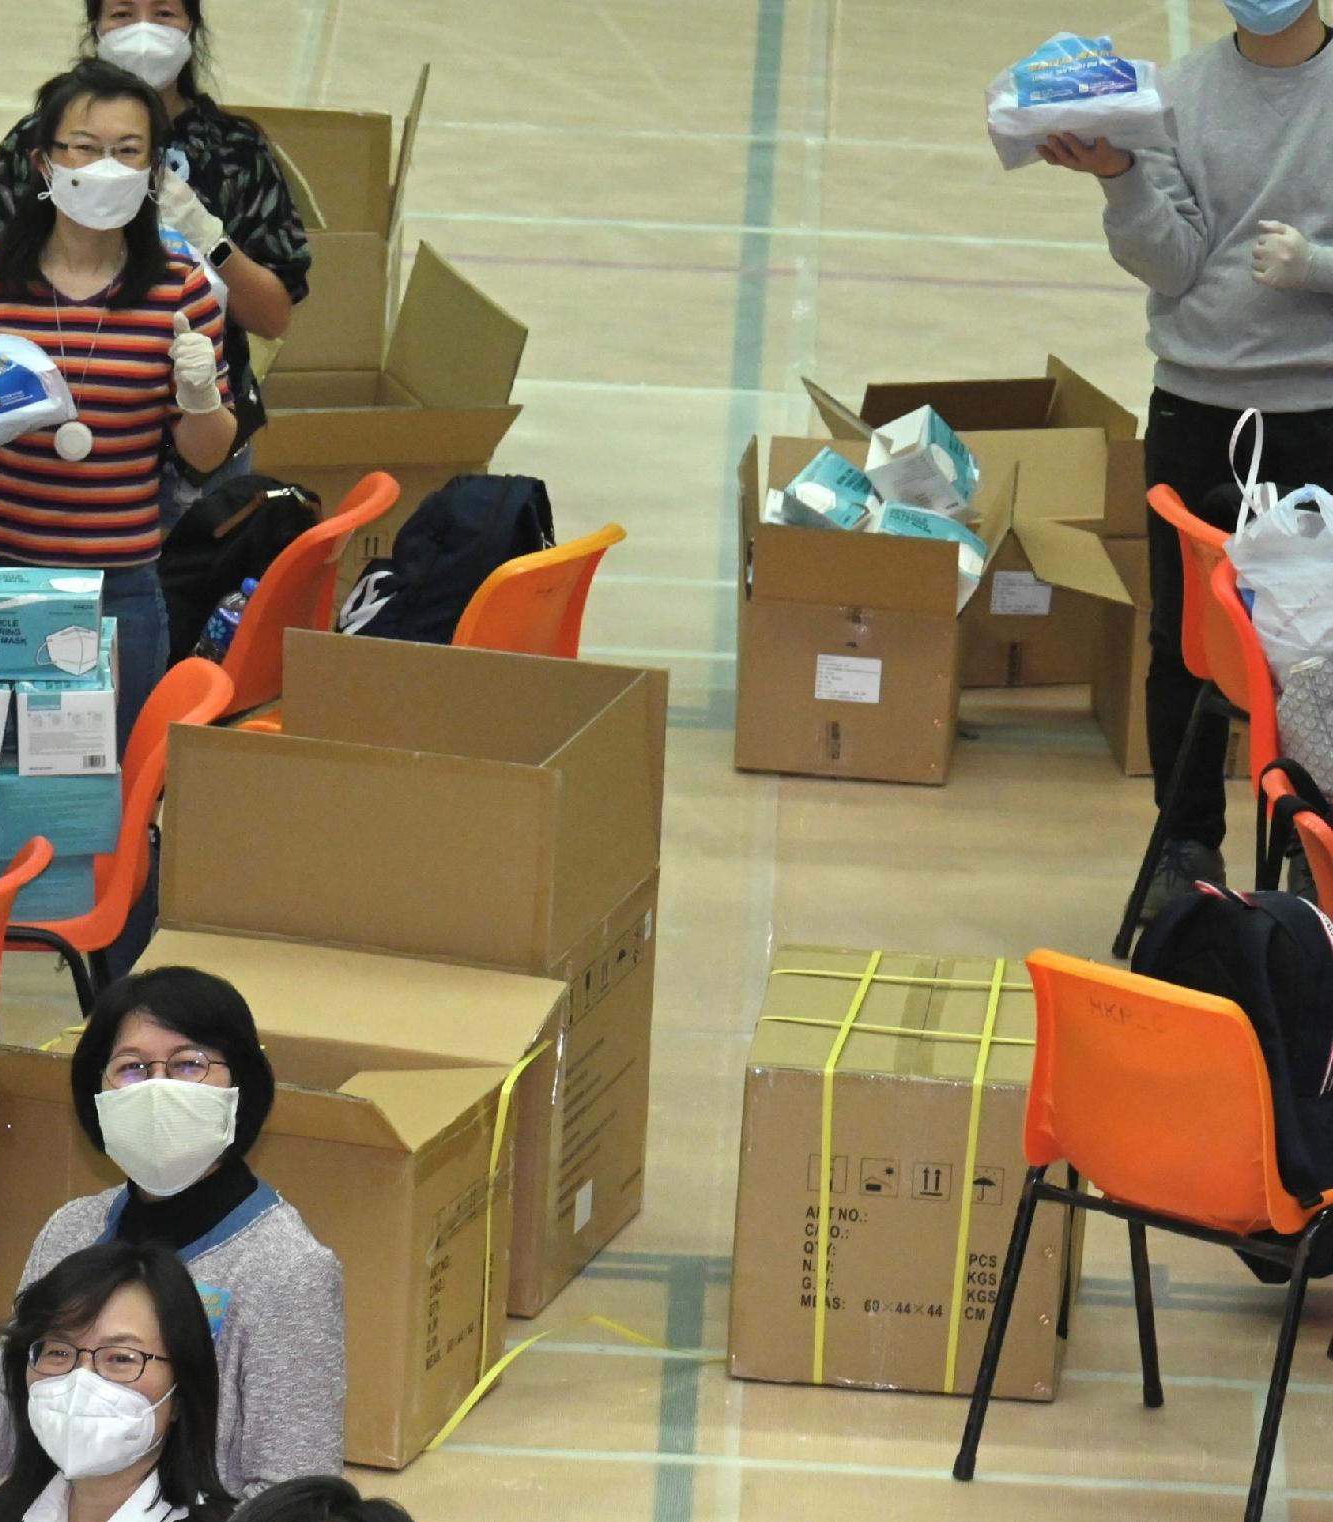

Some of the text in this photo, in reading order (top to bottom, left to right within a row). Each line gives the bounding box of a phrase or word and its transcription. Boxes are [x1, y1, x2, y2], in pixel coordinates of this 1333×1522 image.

[968, 1253, 998, 1268] PCS
[967, 1271, 998, 1286] KGS
[967, 1289, 998, 1304] KGS
[964, 1306, 987, 1321] CM
